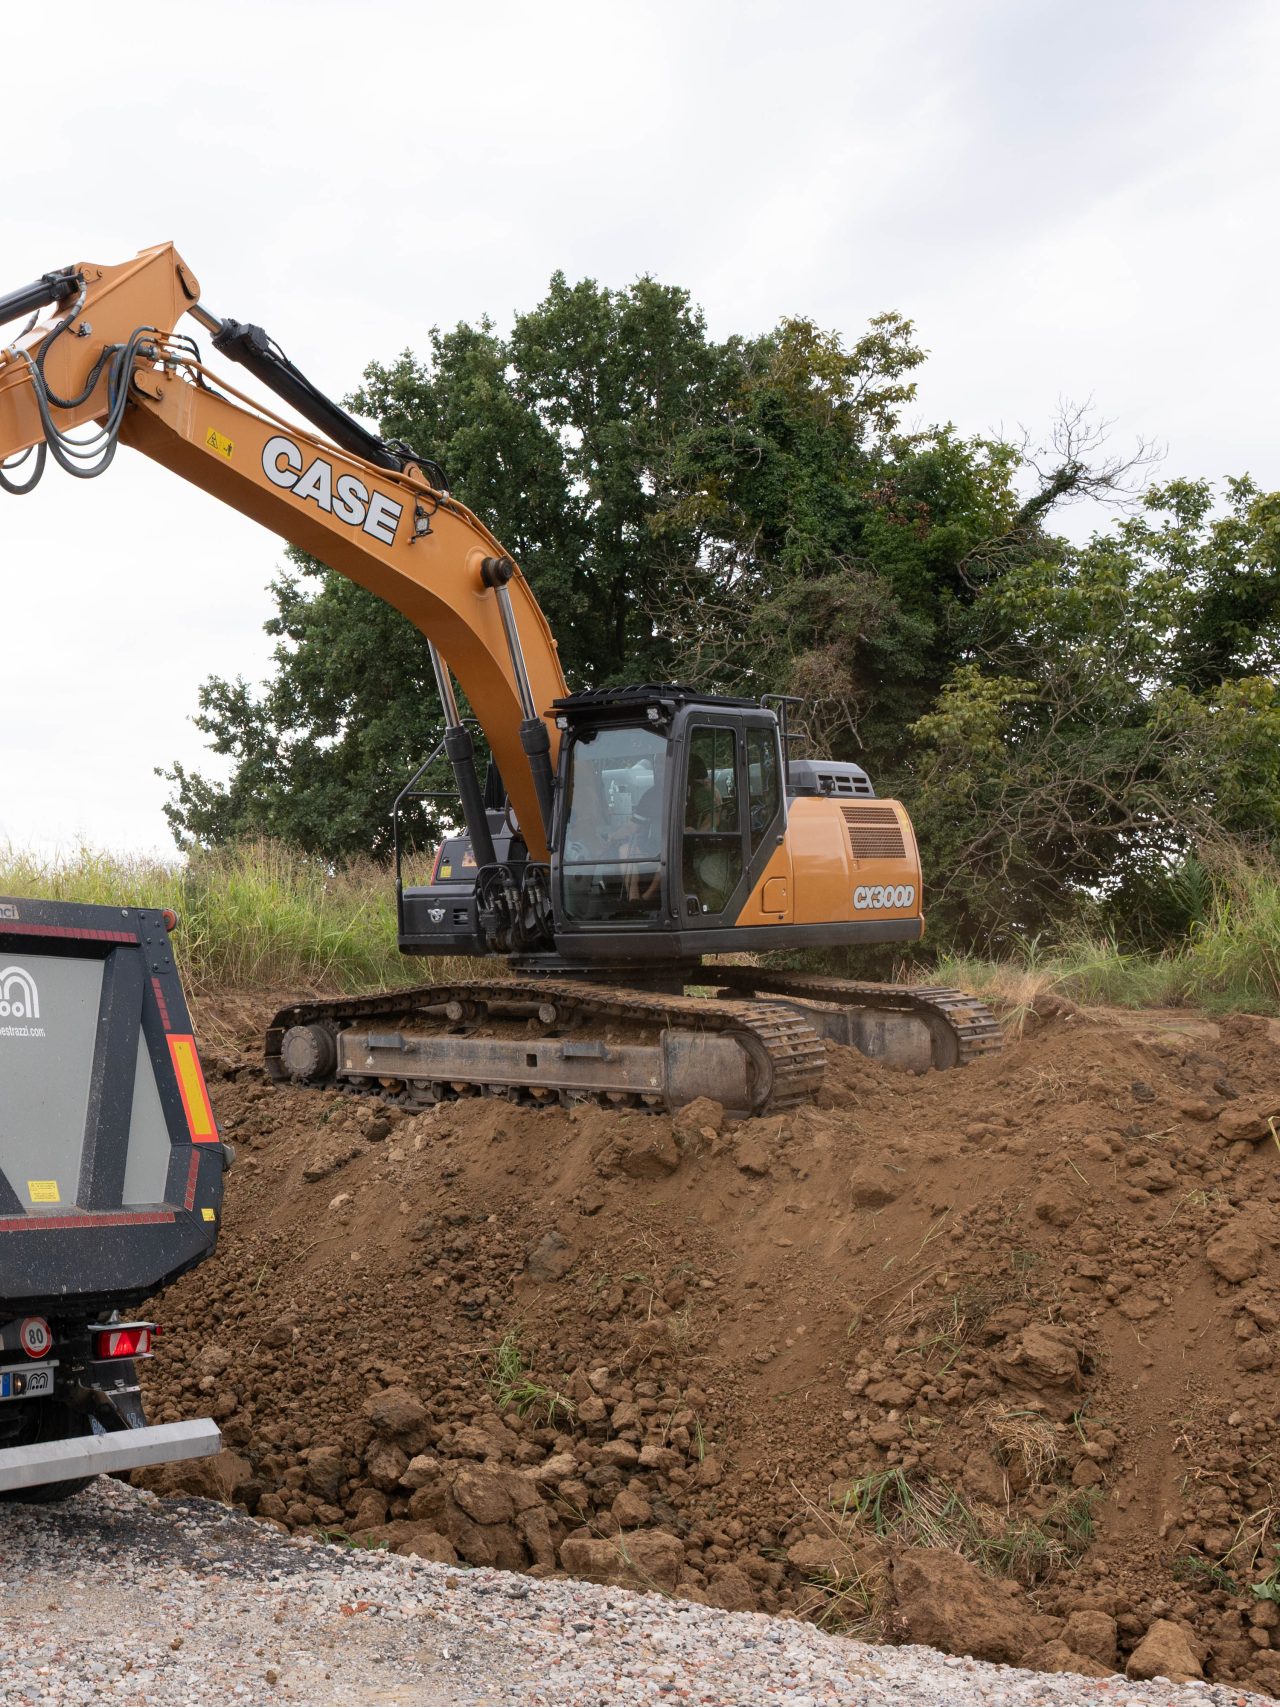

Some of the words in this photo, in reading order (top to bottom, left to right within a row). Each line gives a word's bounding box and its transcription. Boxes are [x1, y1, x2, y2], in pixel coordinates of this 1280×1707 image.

[261, 435, 404, 547] CASE
[853, 884, 915, 910] CX300D
[28, 1328, 44, 1345] 80
